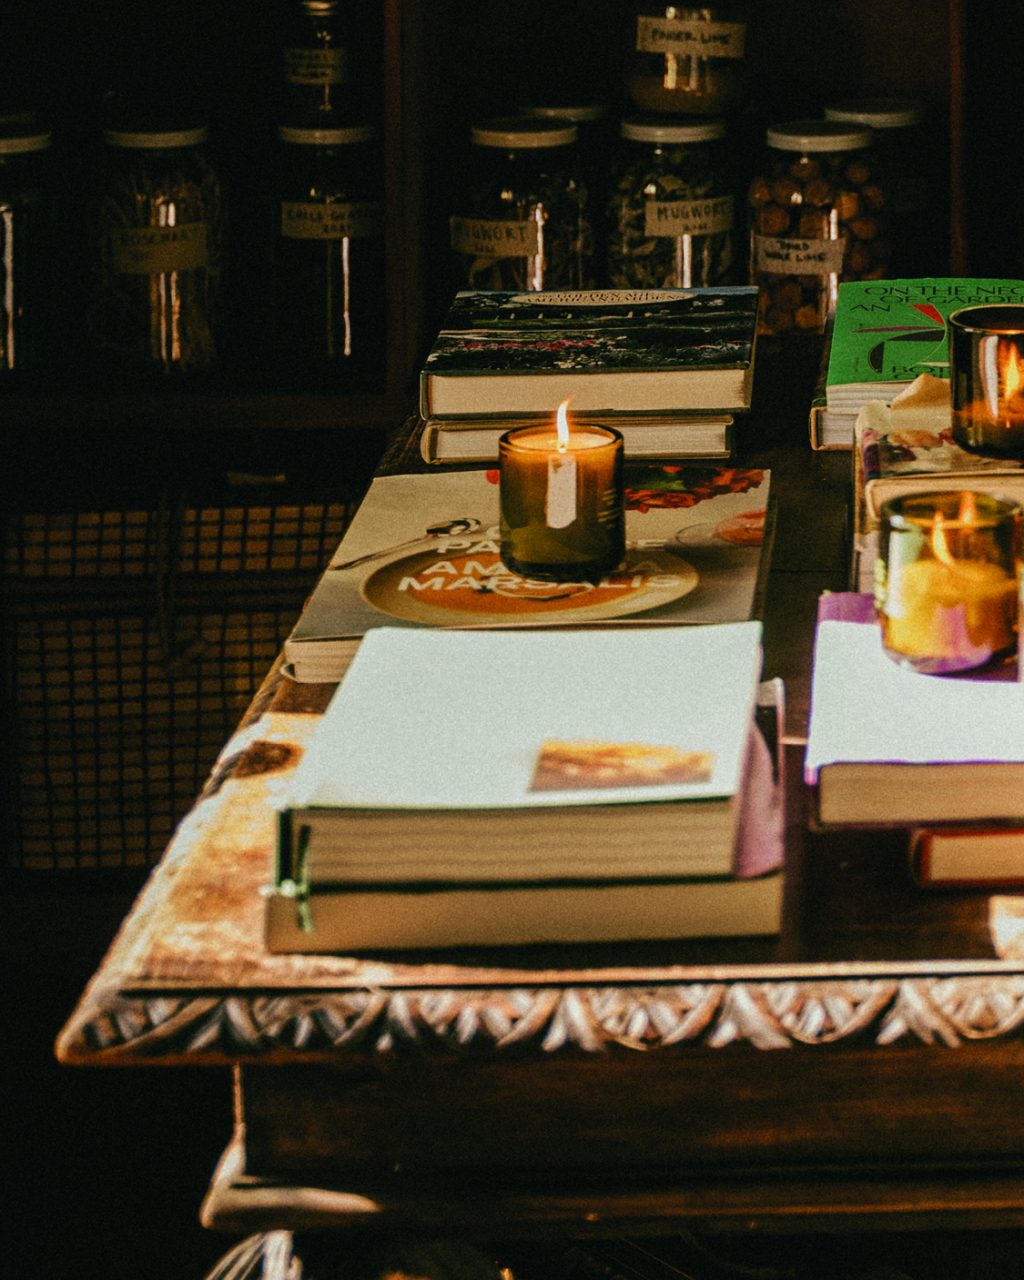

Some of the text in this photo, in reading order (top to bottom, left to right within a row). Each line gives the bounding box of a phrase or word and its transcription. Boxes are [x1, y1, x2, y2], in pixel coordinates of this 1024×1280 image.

[864, 285, 909, 296] ON
[914, 285, 961, 296] THE
[849, 304, 891, 313] AN
